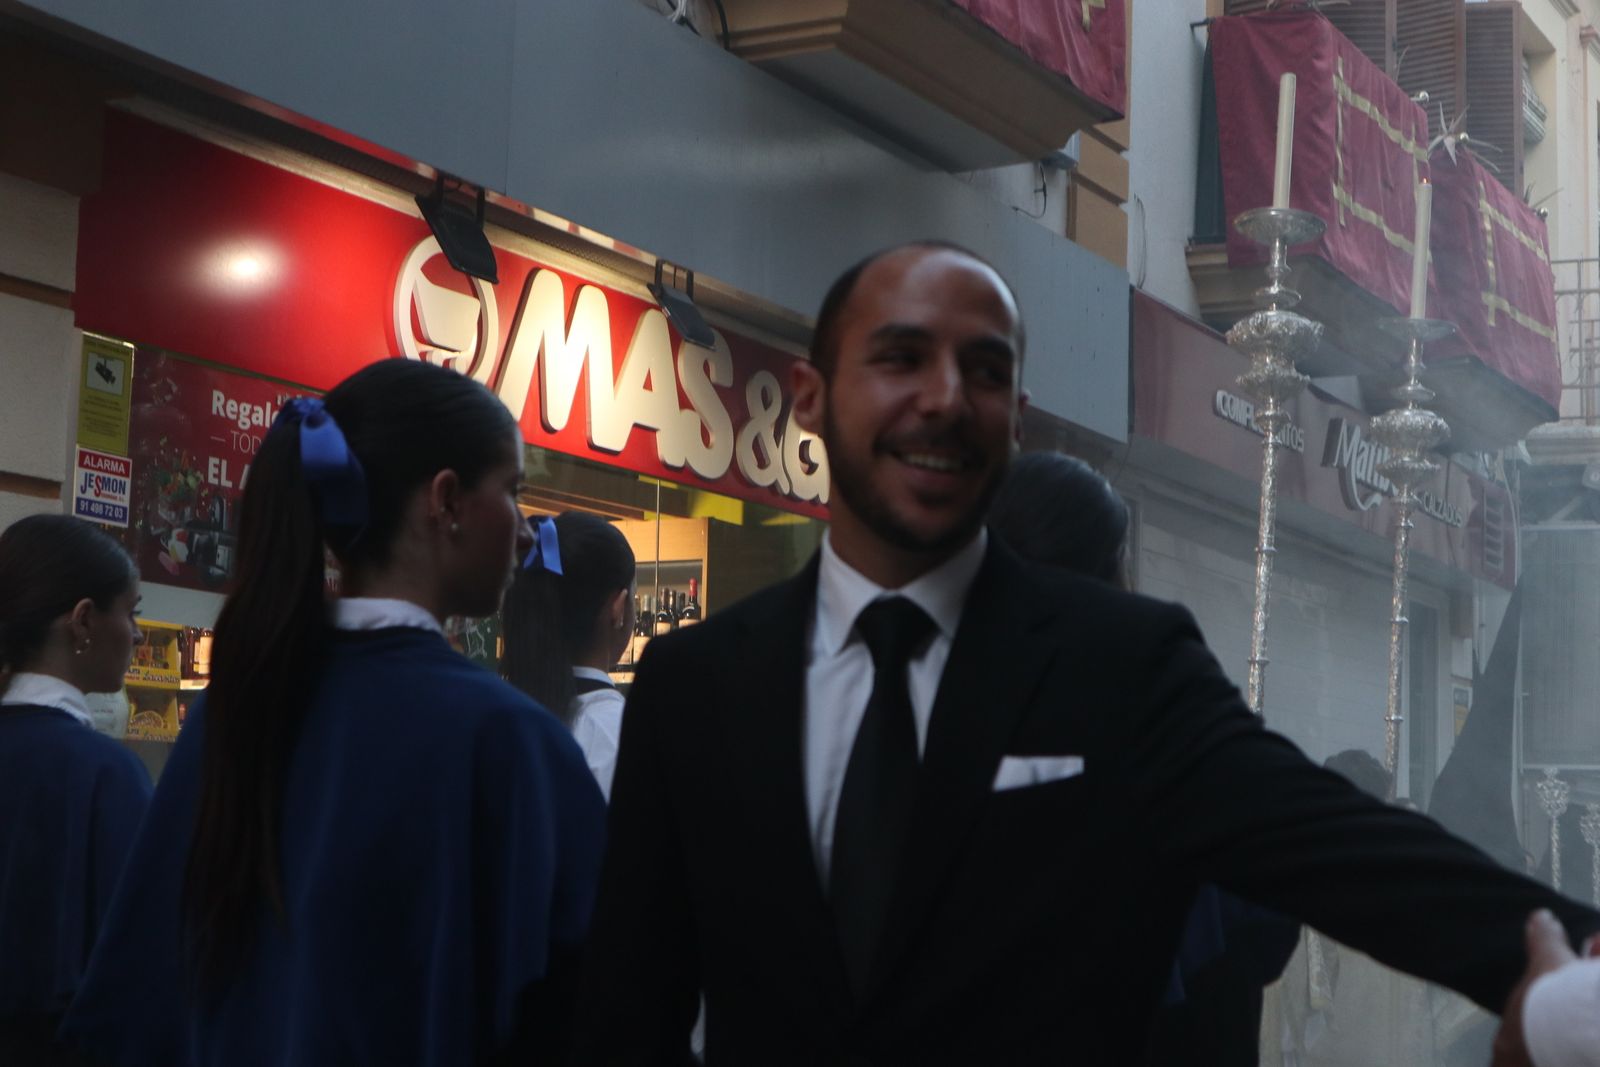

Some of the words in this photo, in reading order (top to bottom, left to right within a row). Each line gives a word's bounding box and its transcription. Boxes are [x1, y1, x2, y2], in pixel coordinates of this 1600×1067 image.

[211, 389, 280, 430] Regal
[83, 455, 125, 474] ALARMA
[207, 456, 233, 488] EL
[80, 472, 126, 497] JESMON
[80, 500, 88, 512] 91
[105, 505, 113, 517] 72
[114, 507, 123, 519] 03
